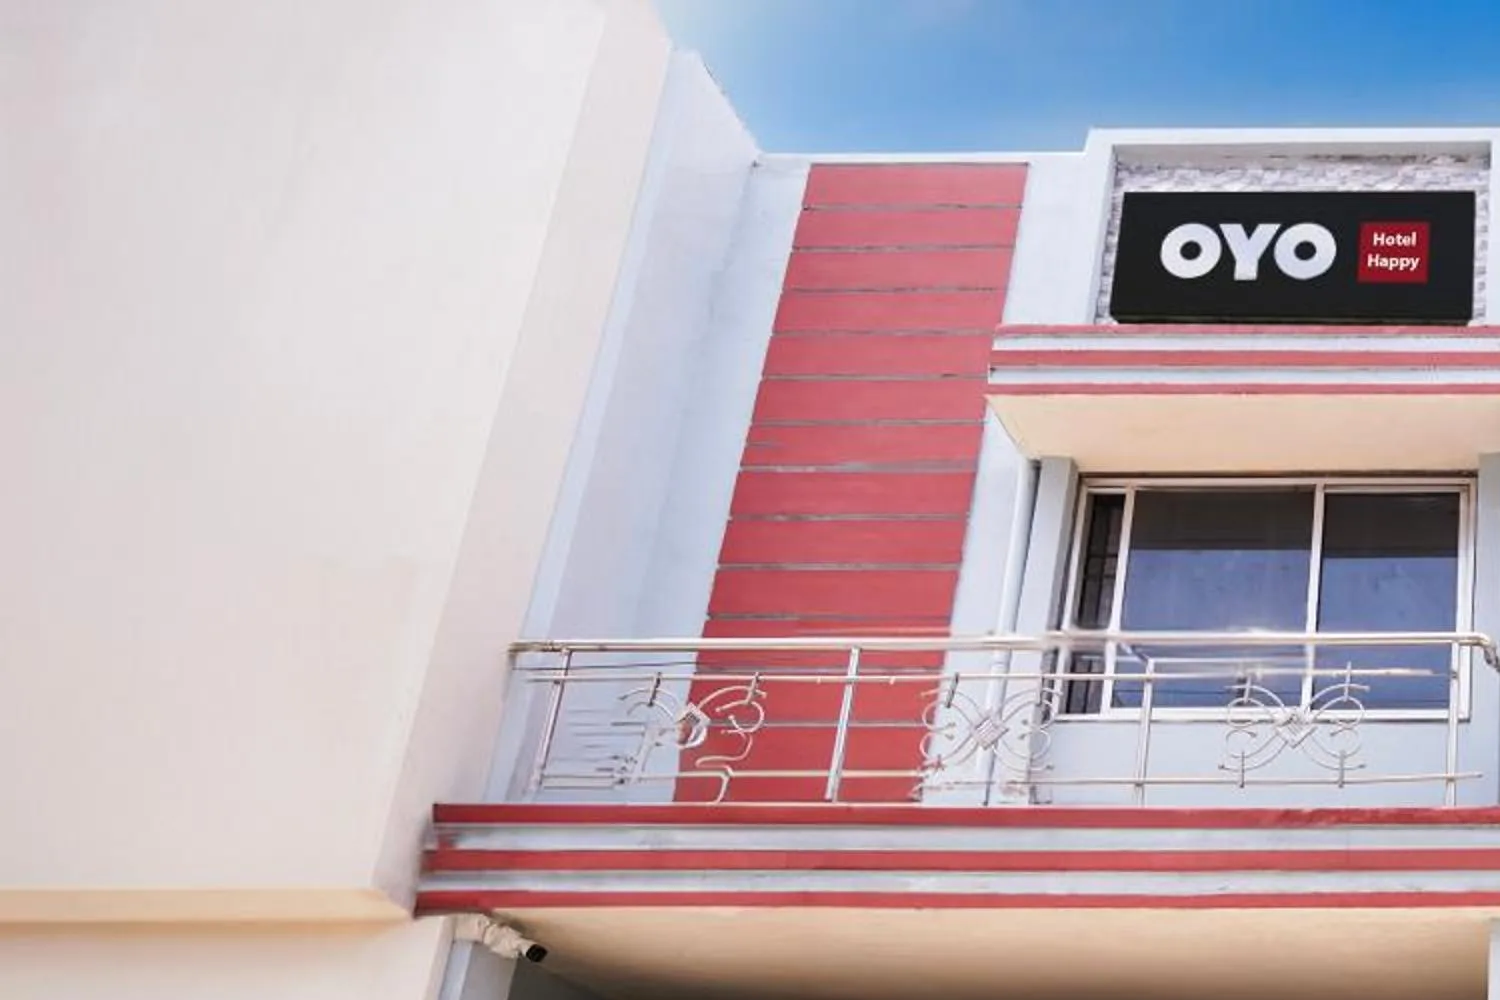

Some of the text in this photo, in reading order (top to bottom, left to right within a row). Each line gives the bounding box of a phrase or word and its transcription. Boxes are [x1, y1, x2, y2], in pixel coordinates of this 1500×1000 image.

[1373, 231, 1417, 247] Hotel
[1160, 223, 1337, 281] OYO
[1367, 253, 1420, 271] Happy
